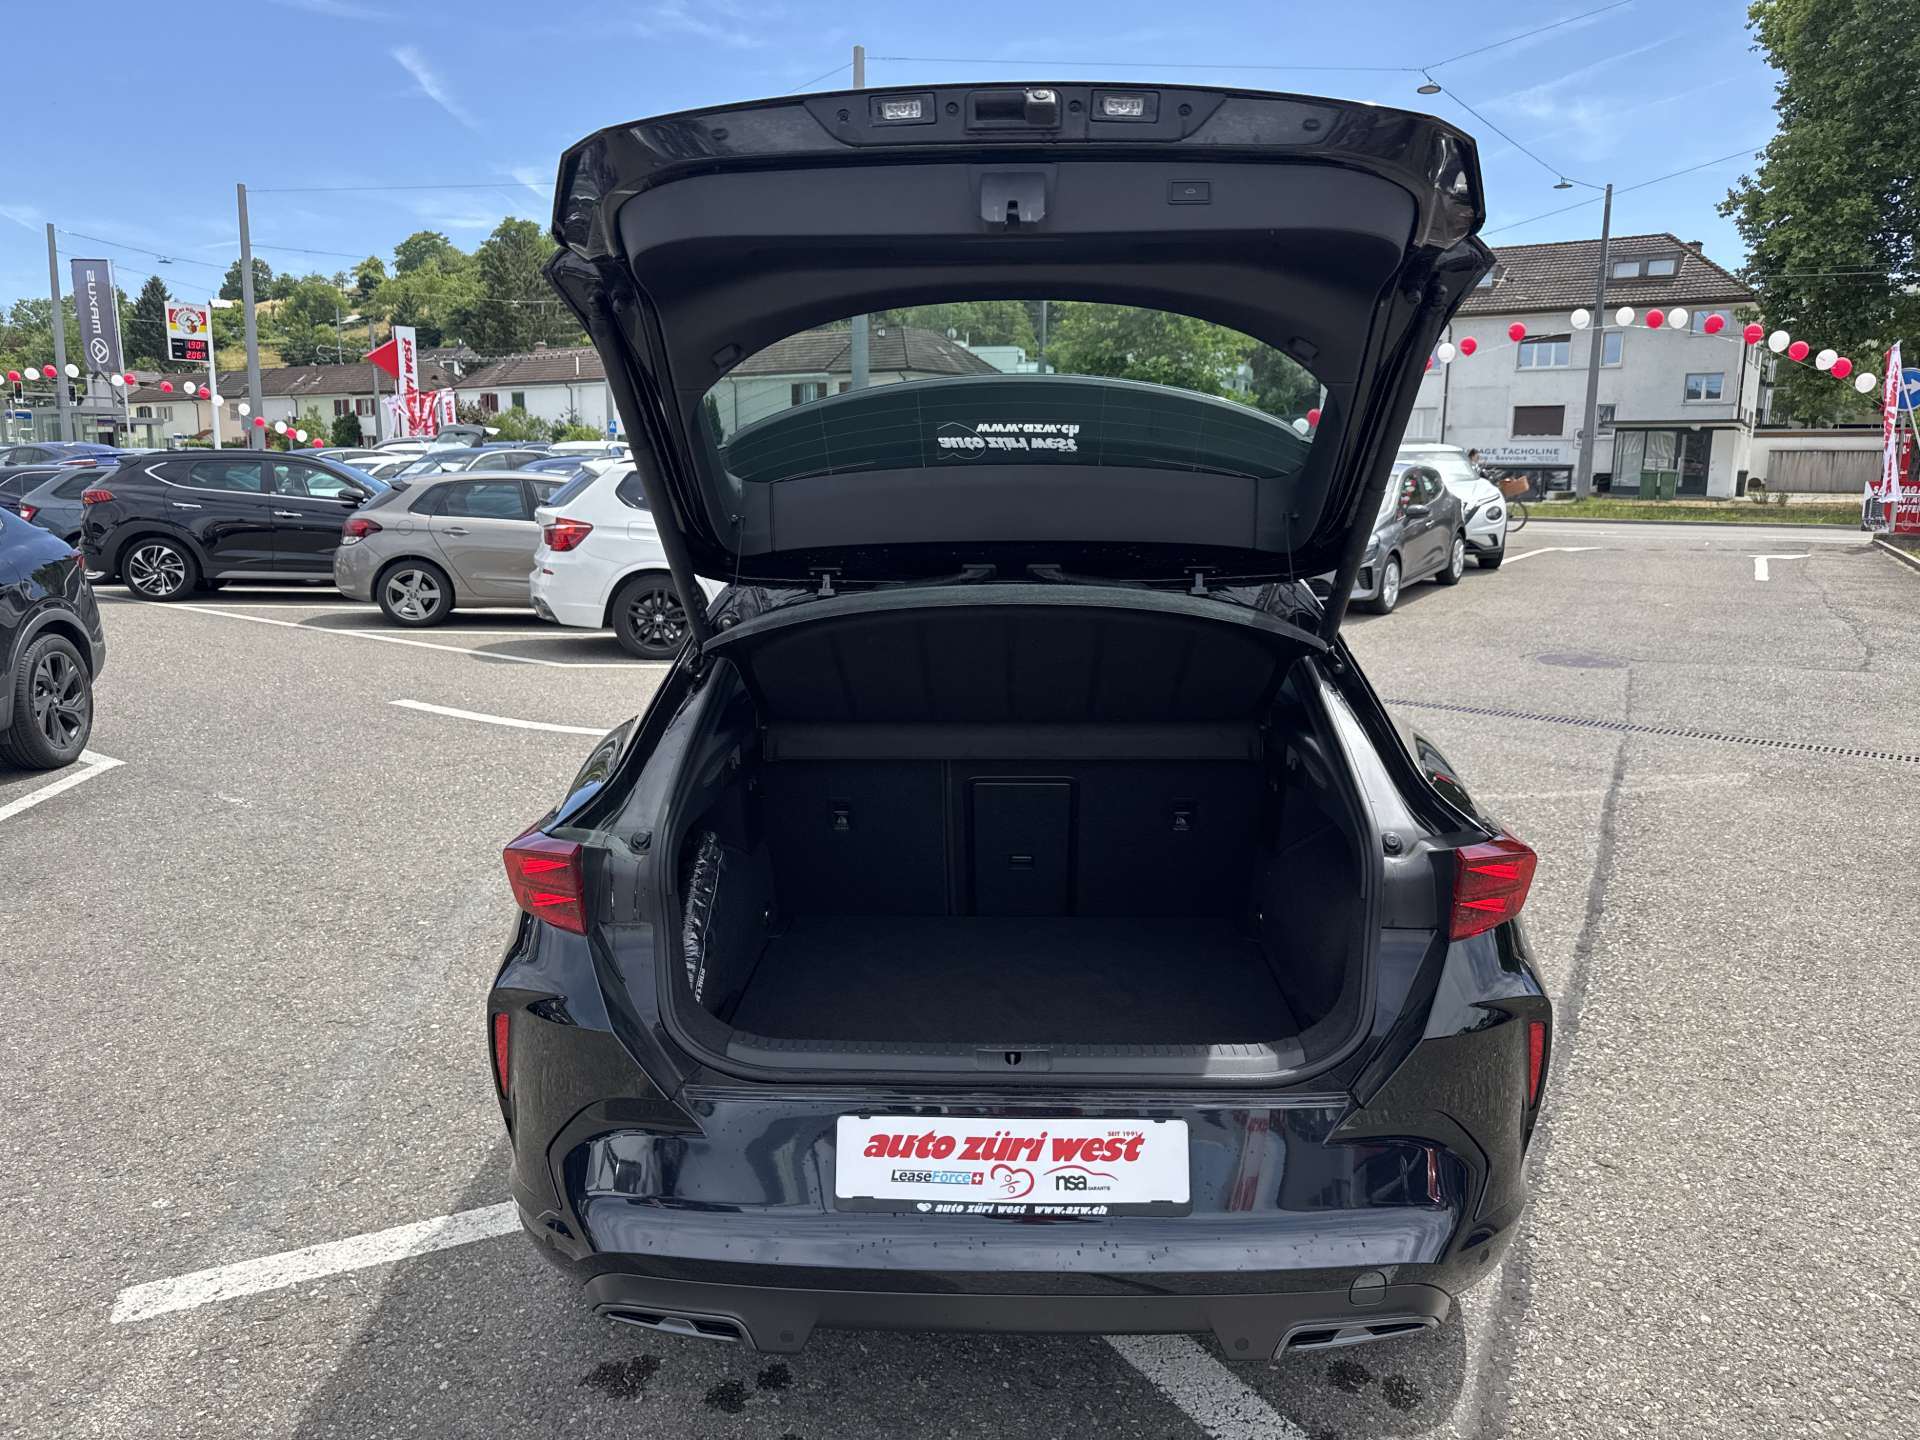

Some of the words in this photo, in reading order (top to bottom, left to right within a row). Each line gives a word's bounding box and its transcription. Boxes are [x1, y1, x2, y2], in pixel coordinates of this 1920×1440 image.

[1501, 447, 1560, 455] TACHOLINE
[863, 1129, 957, 1160] auto
[957, 1130, 1048, 1162] züri
[1052, 1131, 1146, 1163] west
[890, 1169, 971, 1184] LeaseForce
[1055, 1174, 1088, 1191] nsa
[935, 1203, 964, 1213] auto
[966, 1202, 995, 1214] züri
[997, 1204, 1027, 1214] west
